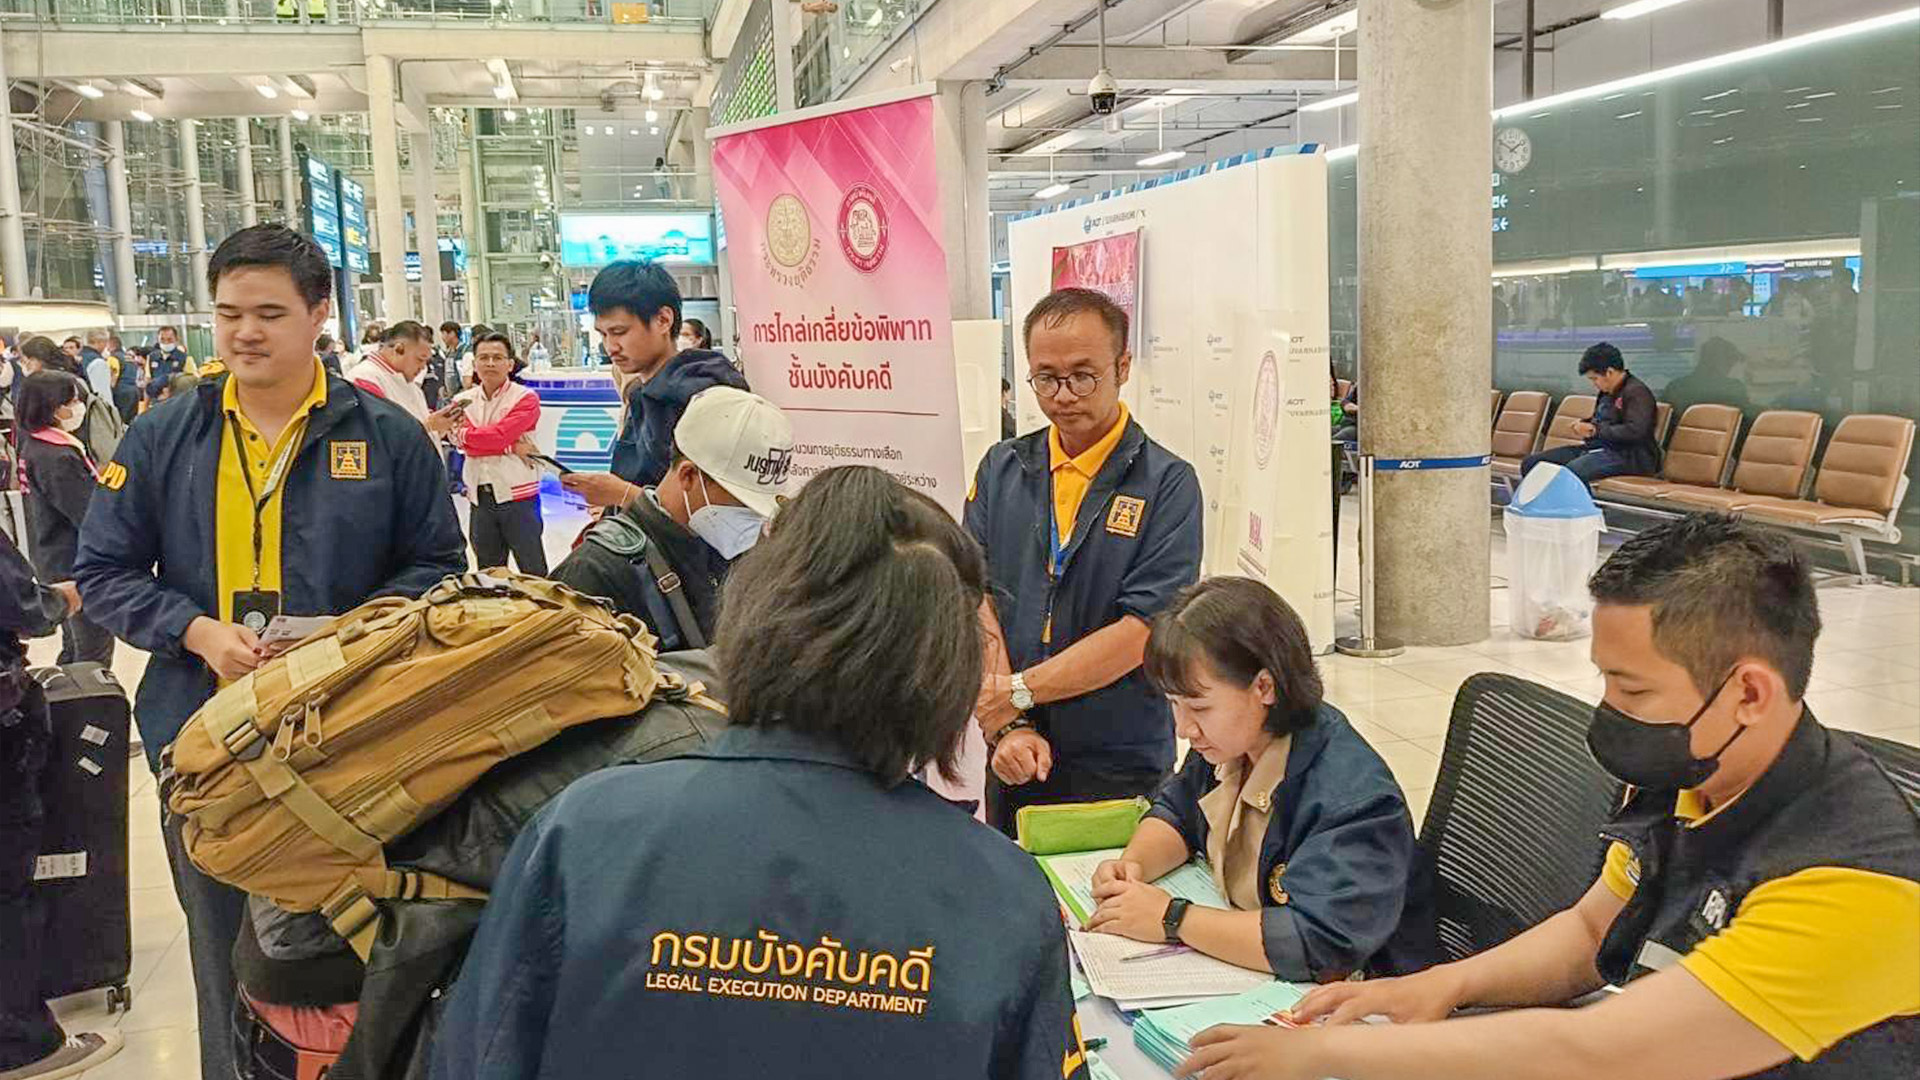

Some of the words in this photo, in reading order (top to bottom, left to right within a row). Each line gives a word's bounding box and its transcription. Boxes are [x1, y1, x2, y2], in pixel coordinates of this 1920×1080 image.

[753, 306, 933, 343] การไกล่เกลี่ยข้อพิพาท
[788, 353, 892, 390] ชั้นบังคับคดี
[793, 443, 902, 460] บวนการยุติธรรมทางเลือก
[1399, 460, 1421, 469] AOT
[650, 929, 935, 992] กรมบังคับคดี
[646, 973, 703, 992] LEGAL
[707, 977, 808, 1002] EXECUTION
[813, 987, 927, 1015] DEPARTMENT
